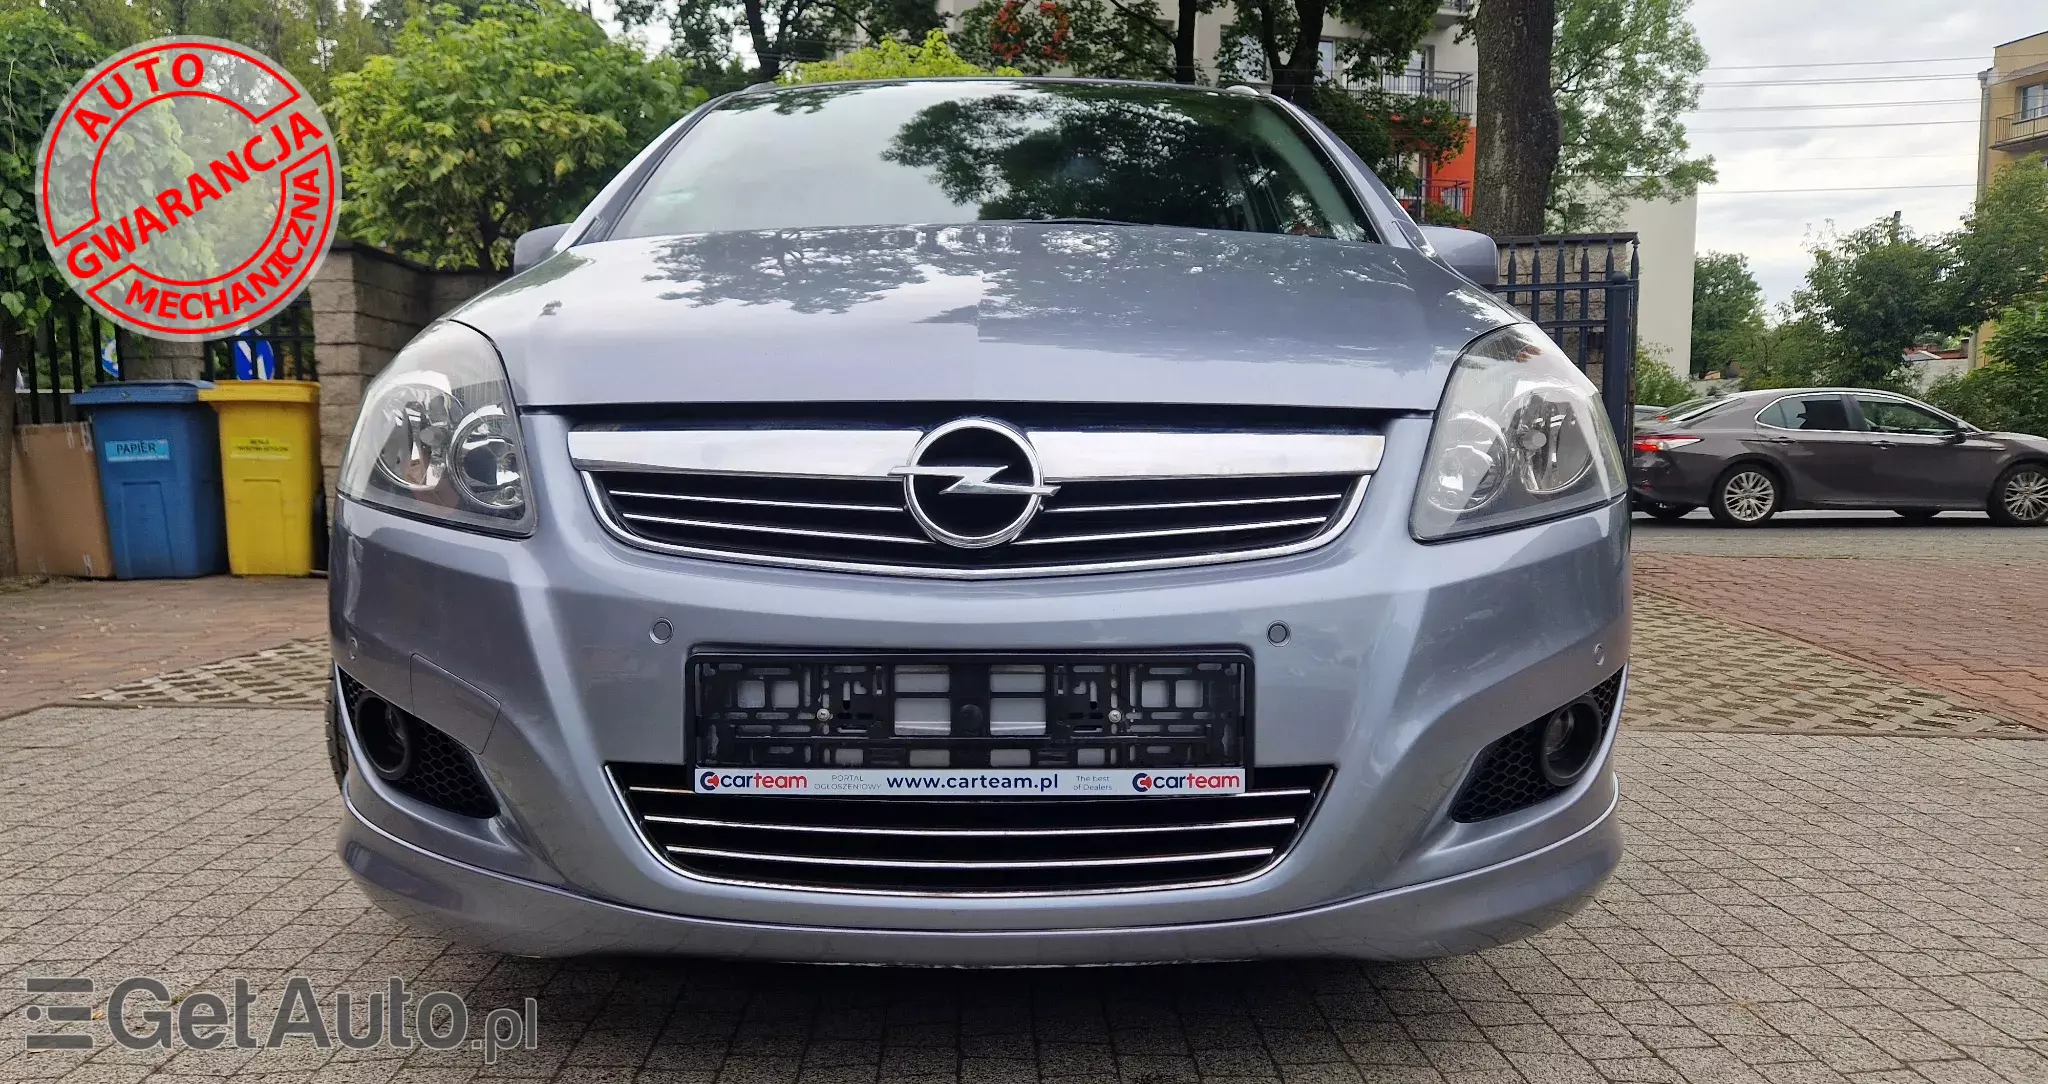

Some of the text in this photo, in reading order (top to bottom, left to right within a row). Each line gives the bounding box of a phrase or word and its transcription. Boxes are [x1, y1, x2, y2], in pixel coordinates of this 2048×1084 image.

[116, 442, 157, 454] PAPIER
[720, 772, 808, 789] carteam
[831, 774, 864, 782] PORTAL
[886, 773, 1058, 792] www.carteam.pl
[1153, 772, 1240, 789] carteam
[1073, 783, 1112, 791] of Dealers
